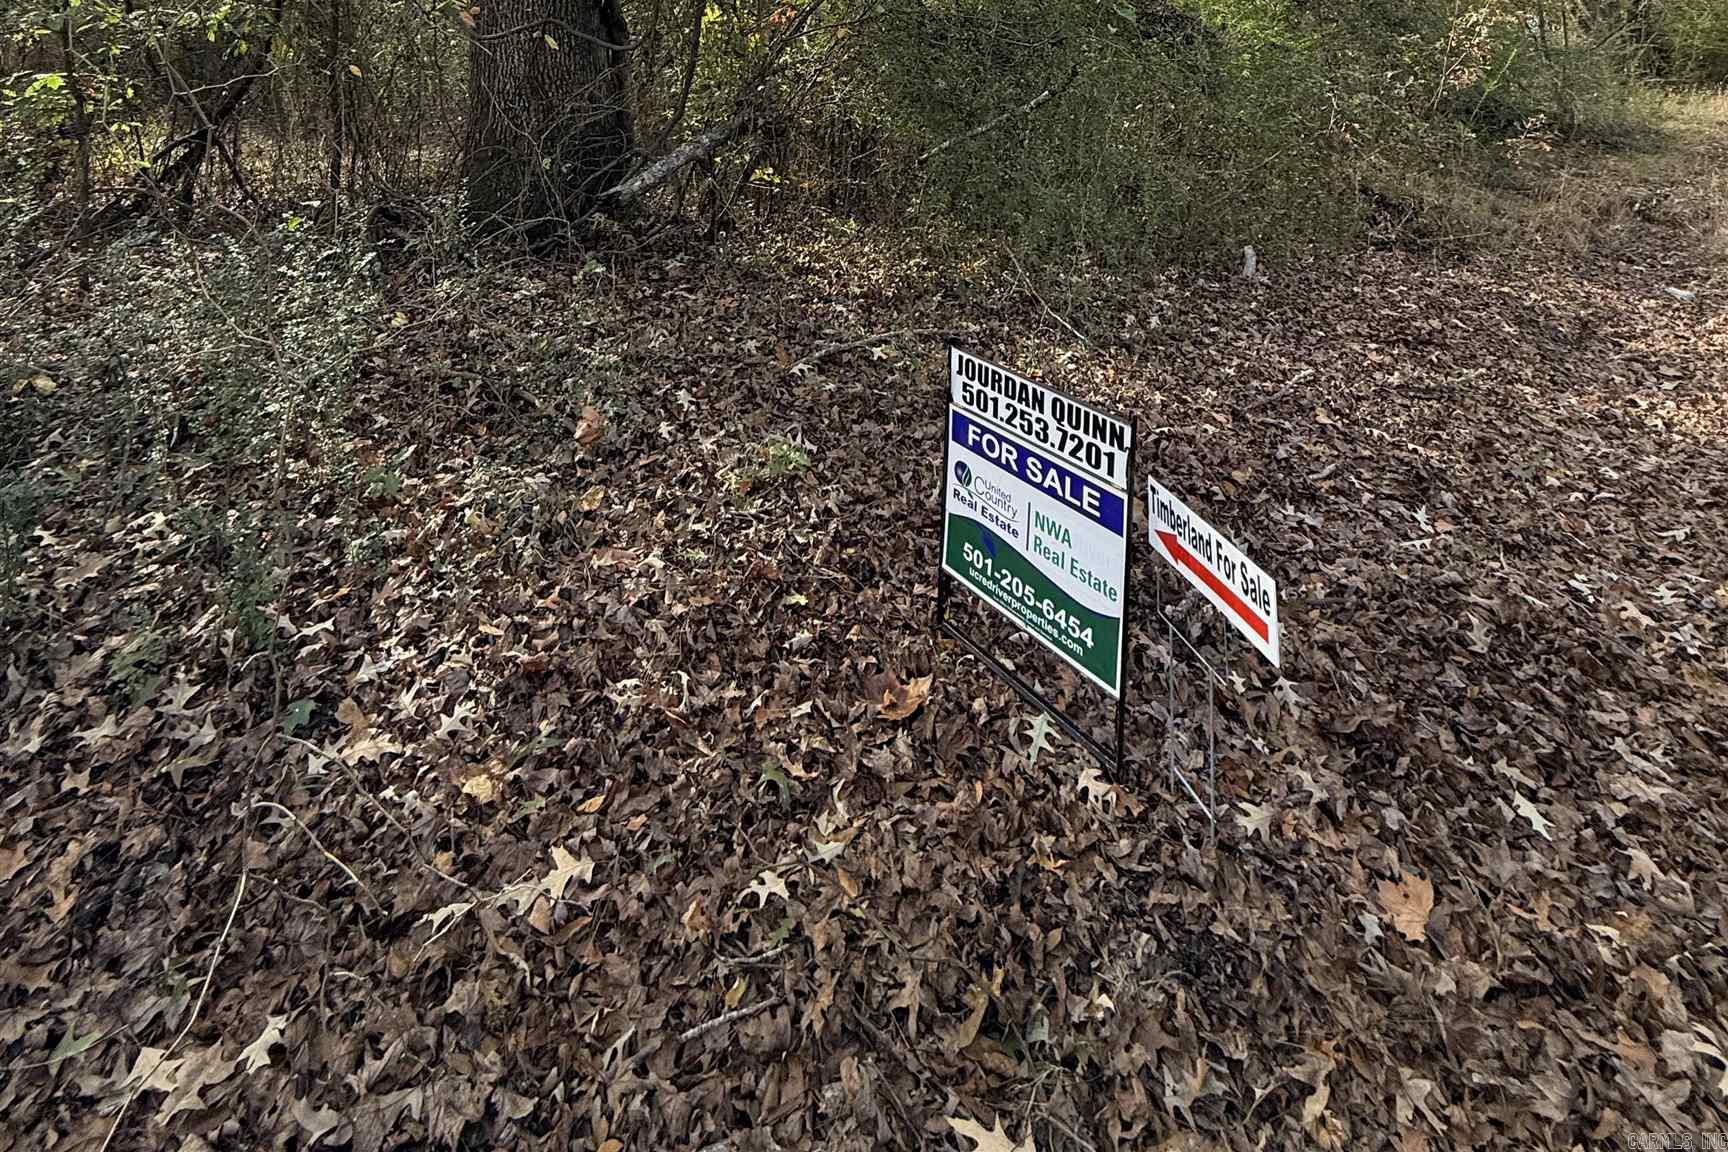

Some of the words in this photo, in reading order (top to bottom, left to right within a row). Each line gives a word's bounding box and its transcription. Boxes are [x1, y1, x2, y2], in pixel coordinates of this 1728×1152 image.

[957, 355, 1044, 415] JOURDAN
[1051, 397, 1125, 451] QUINN
[962, 381, 1115, 479] 501.253.7201
[953, 488, 977, 512] Real
[981, 505, 1019, 539] Estate
[968, 424, 1019, 472] FOR
[1026, 457, 1101, 518] SALE
[974, 476, 1018, 519] Country
[985, 479, 1012, 502] United
[1033, 535, 1065, 570] Real
[1070, 558, 1118, 602] Estate
[1035, 511, 1072, 549] NWA
[1150, 485, 1213, 565] Timberland
[1216, 539, 1236, 585] For
[1240, 561, 1271, 616] Sale
[962, 542, 1094, 649] 501-205-6454
[969, 566, 1084, 656] ucredriverproperties.com
